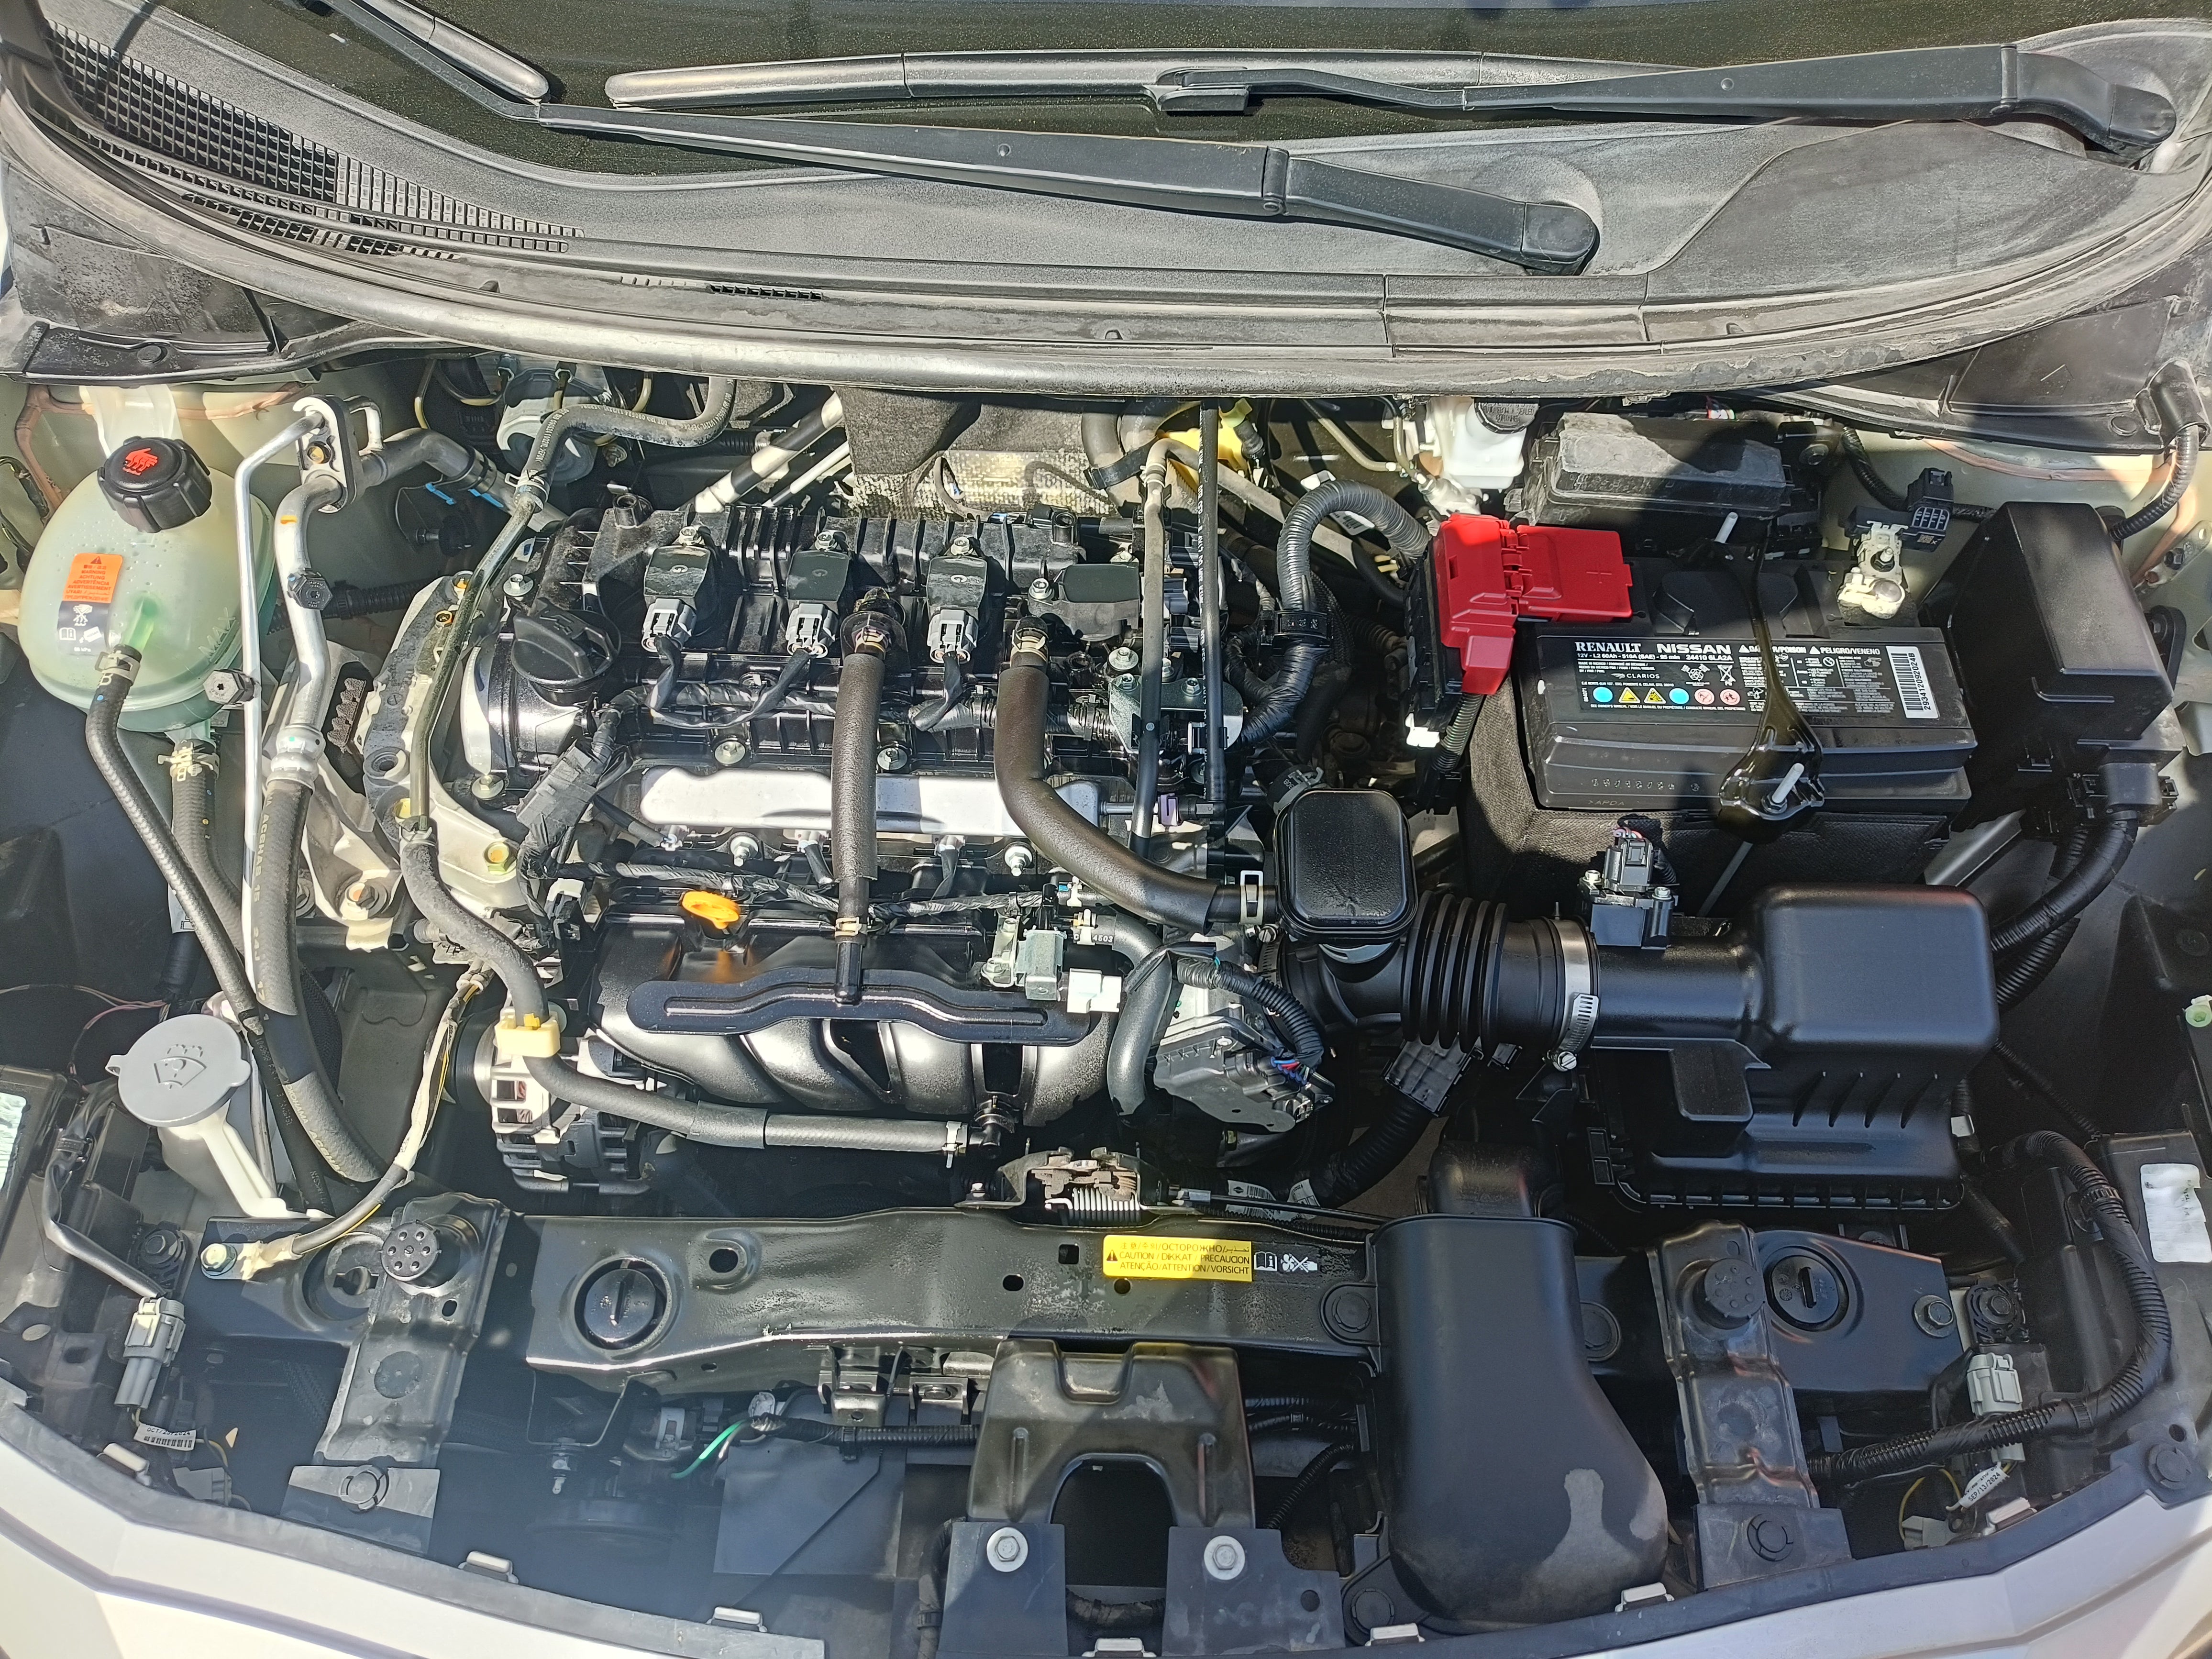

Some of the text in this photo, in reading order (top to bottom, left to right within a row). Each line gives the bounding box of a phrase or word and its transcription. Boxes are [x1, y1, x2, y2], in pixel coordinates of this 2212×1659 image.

[1574, 641, 1732, 654] RENAULT NISSAN
[1820, 647, 1881, 655] PELIGRO/VENENO
[284, 1079, 309, 1124] YOKOHAMA
[1119, 1251, 1154, 1260] CAUTION
[1200, 1254, 1250, 1264] PRECAUCION
[1968, 1471, 2001, 1502] SEP/13/2024
